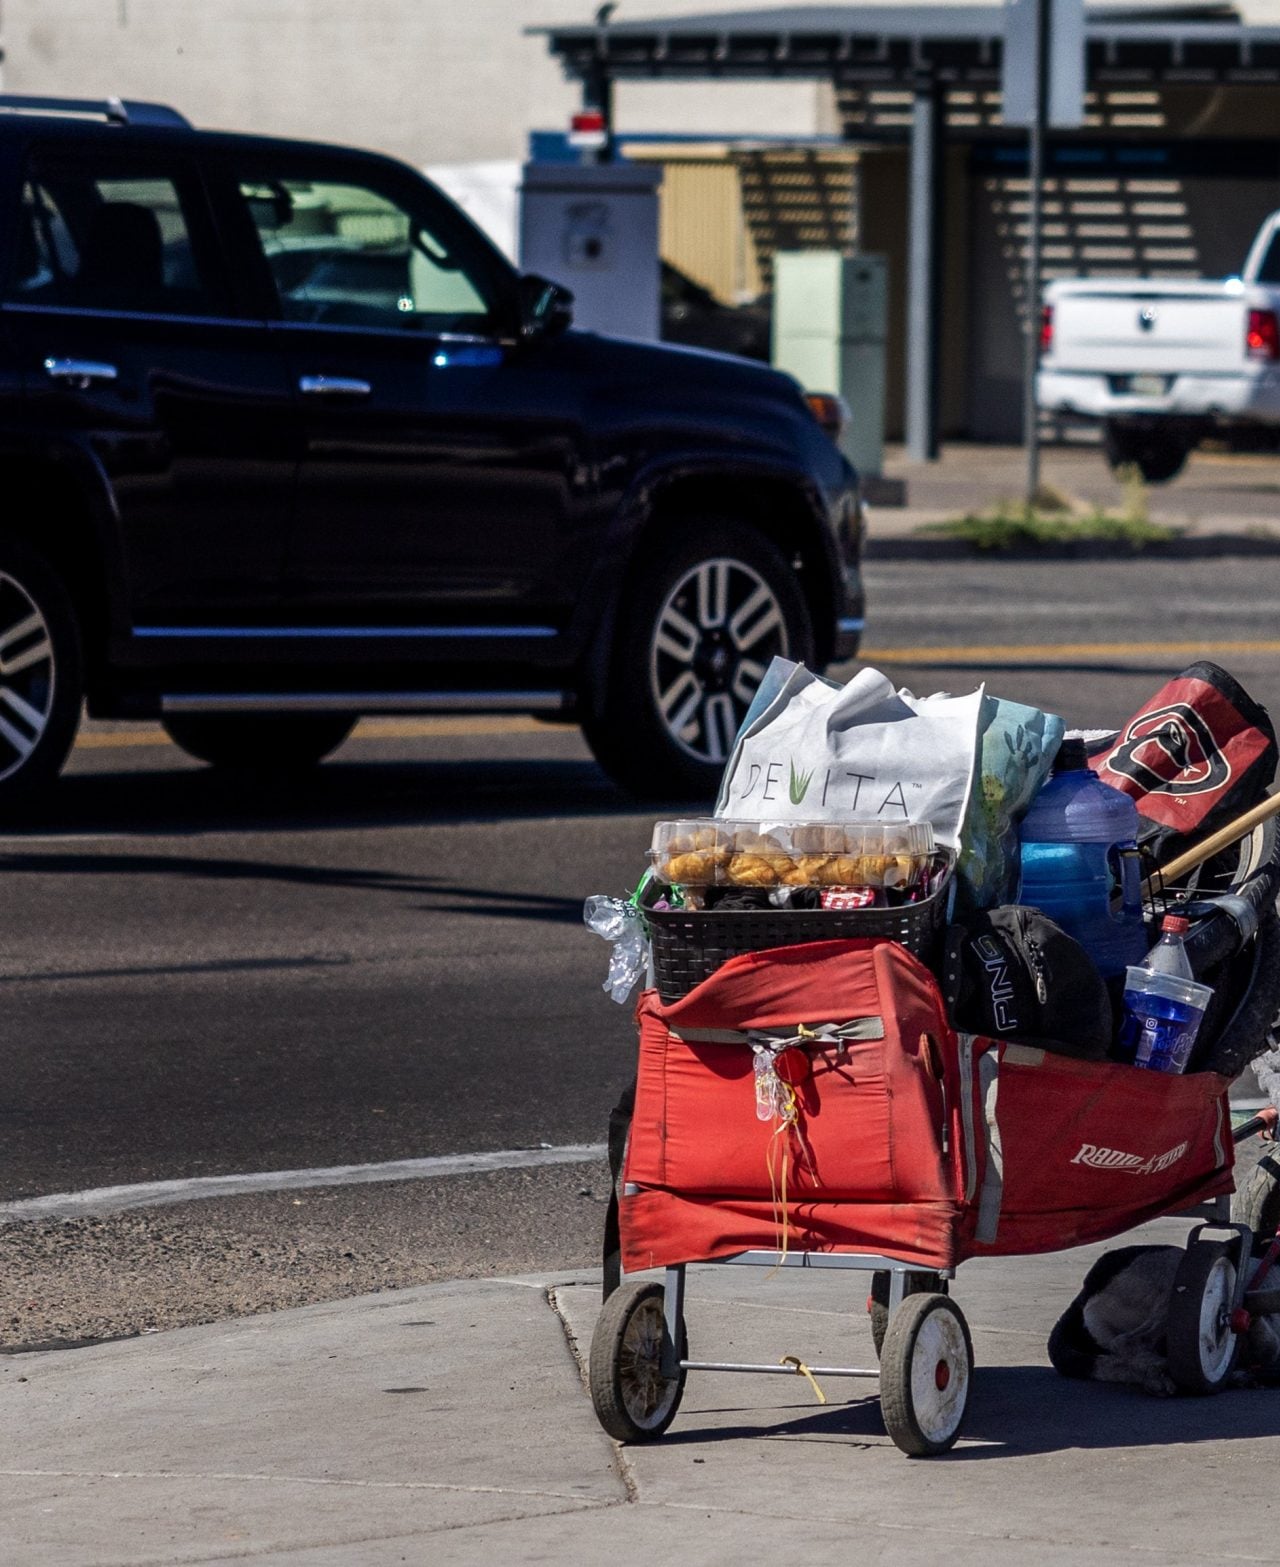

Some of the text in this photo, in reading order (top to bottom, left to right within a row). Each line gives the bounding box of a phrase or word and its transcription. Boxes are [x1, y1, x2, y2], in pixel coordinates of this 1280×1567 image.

[740, 755, 908, 818] DEVITA
[969, 934, 1018, 1031] PING
[1070, 1143, 1145, 1169] RADIO
